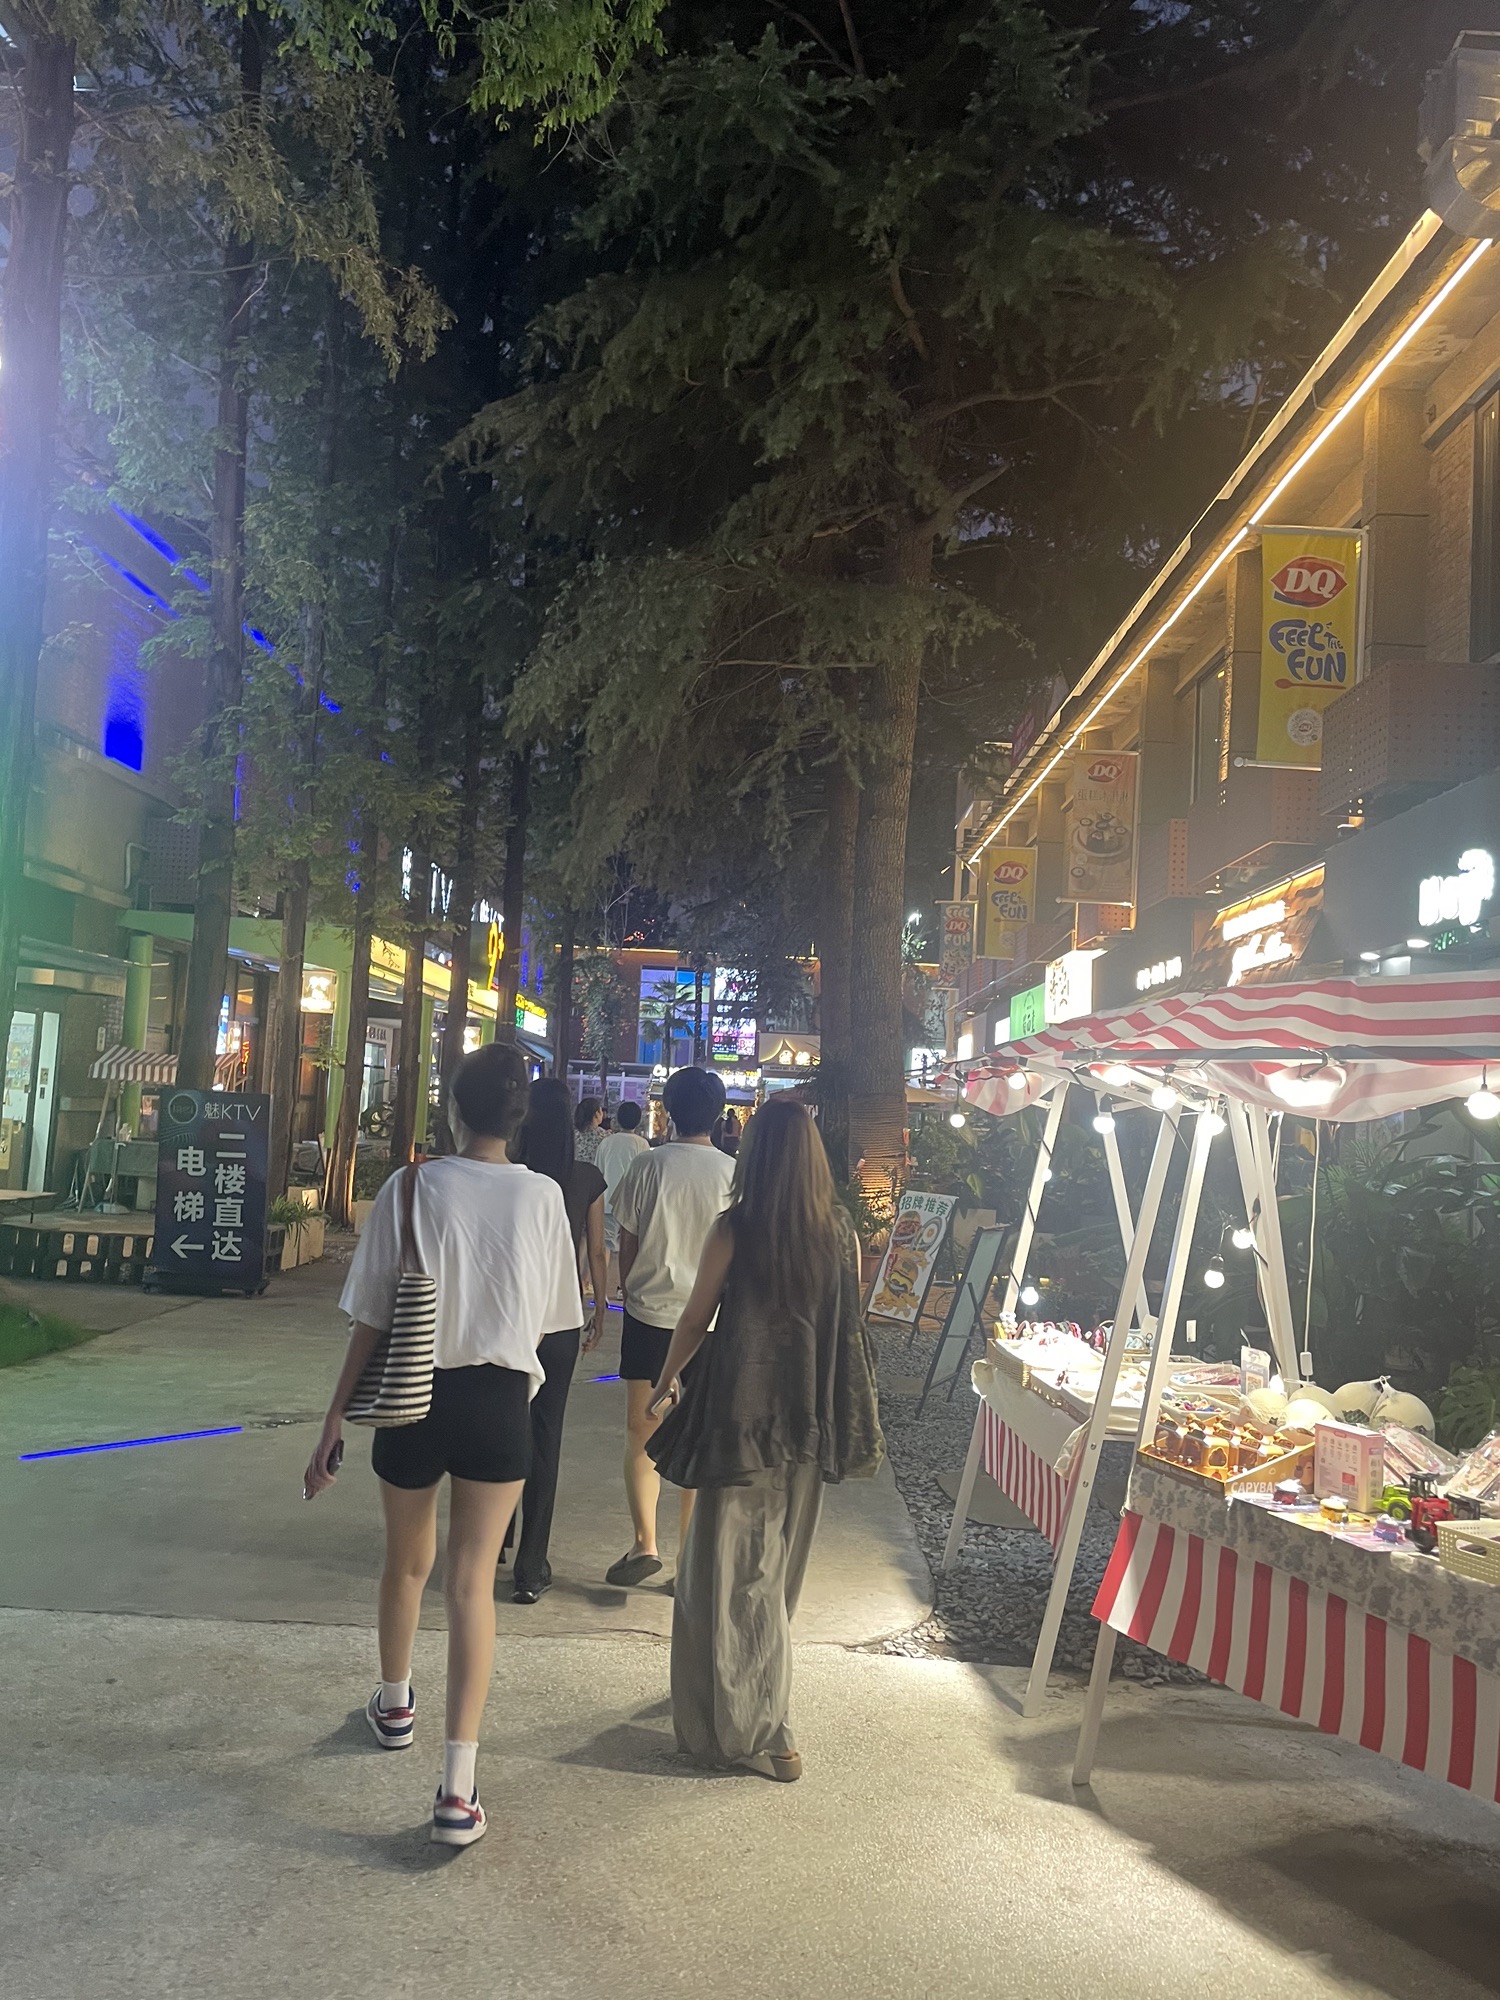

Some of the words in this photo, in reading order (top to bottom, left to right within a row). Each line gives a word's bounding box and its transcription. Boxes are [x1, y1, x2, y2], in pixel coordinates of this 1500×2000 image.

[1284, 567, 1337, 598] DQ
[1269, 619, 1326, 654] FEEL
[1324, 631, 1344, 650] THE
[1287, 649, 1347, 683] FUN
[1092, 764, 1118, 779] DQ
[1000, 866, 1024, 879] DQ
[999, 904, 1028, 919] FUN
[949, 920, 967, 931] DQ
[173, 1145, 207, 1223] 电梯
[211, 1133, 247, 1262] 二楼直达
[901, 1196, 949, 1217] 招牌推荐
